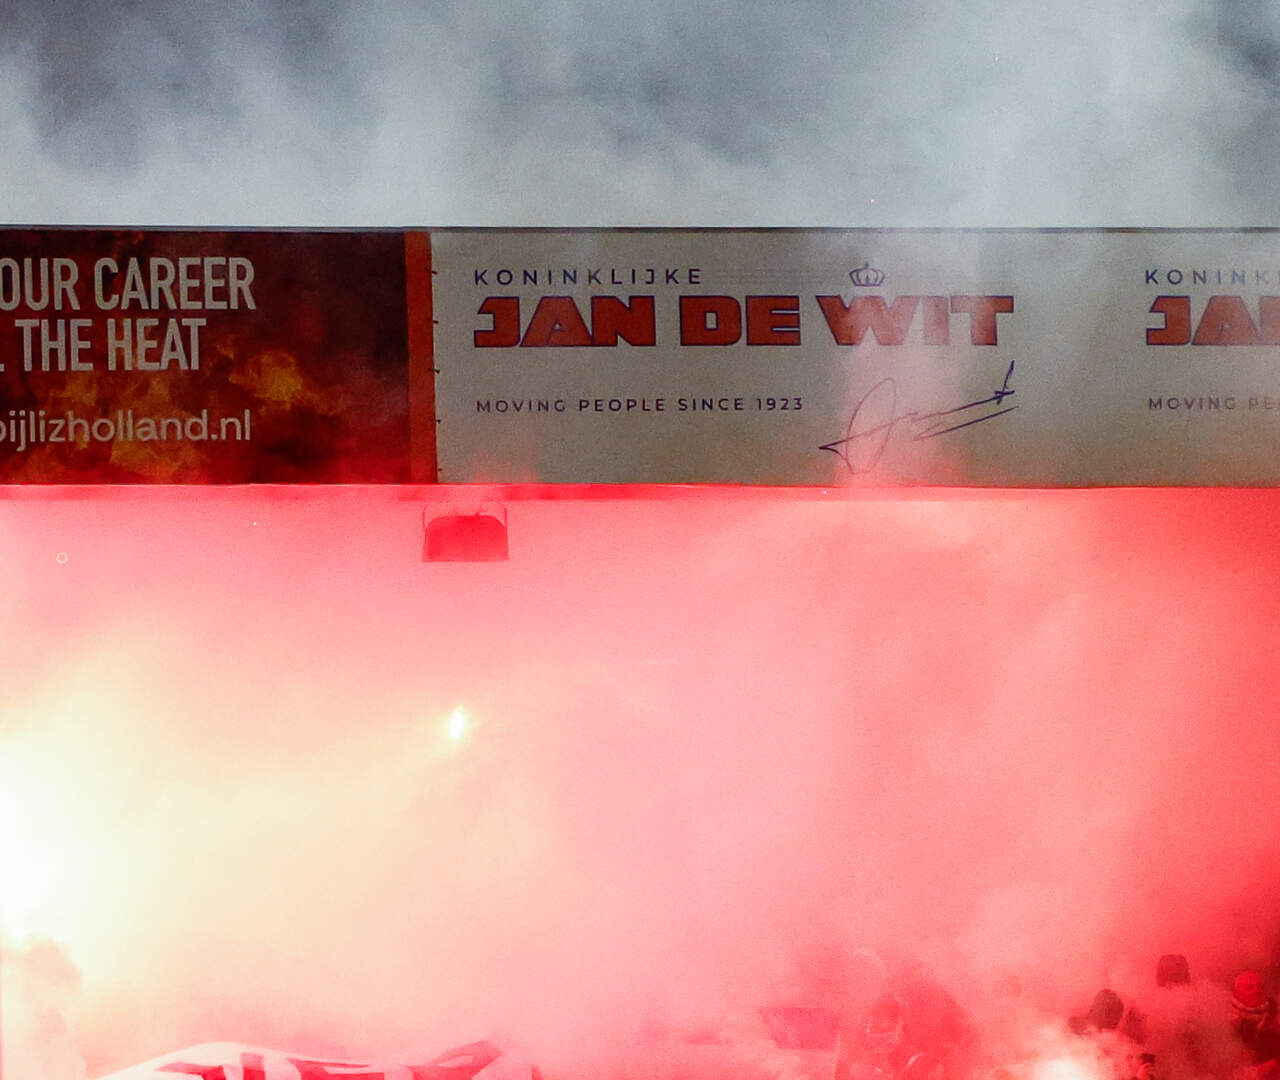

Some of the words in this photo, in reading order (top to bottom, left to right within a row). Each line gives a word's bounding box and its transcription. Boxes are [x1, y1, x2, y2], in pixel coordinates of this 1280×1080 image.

[93, 256, 257, 311] CAREER
[473, 268, 703, 286] KONINKLIJKE
[473, 295, 657, 348] JAN
[678, 295, 802, 347] DE
[815, 294, 1015, 347] WIT
[15, 318, 94, 372] THE
[106, 317, 207, 371] HEAT
[476, 398, 566, 413] MOVING
[578, 398, 666, 412] PEOPLE
[677, 397, 745, 412] SINCE
[756, 396, 804, 412] 1923
[1149, 396, 1236, 411] MOVING
